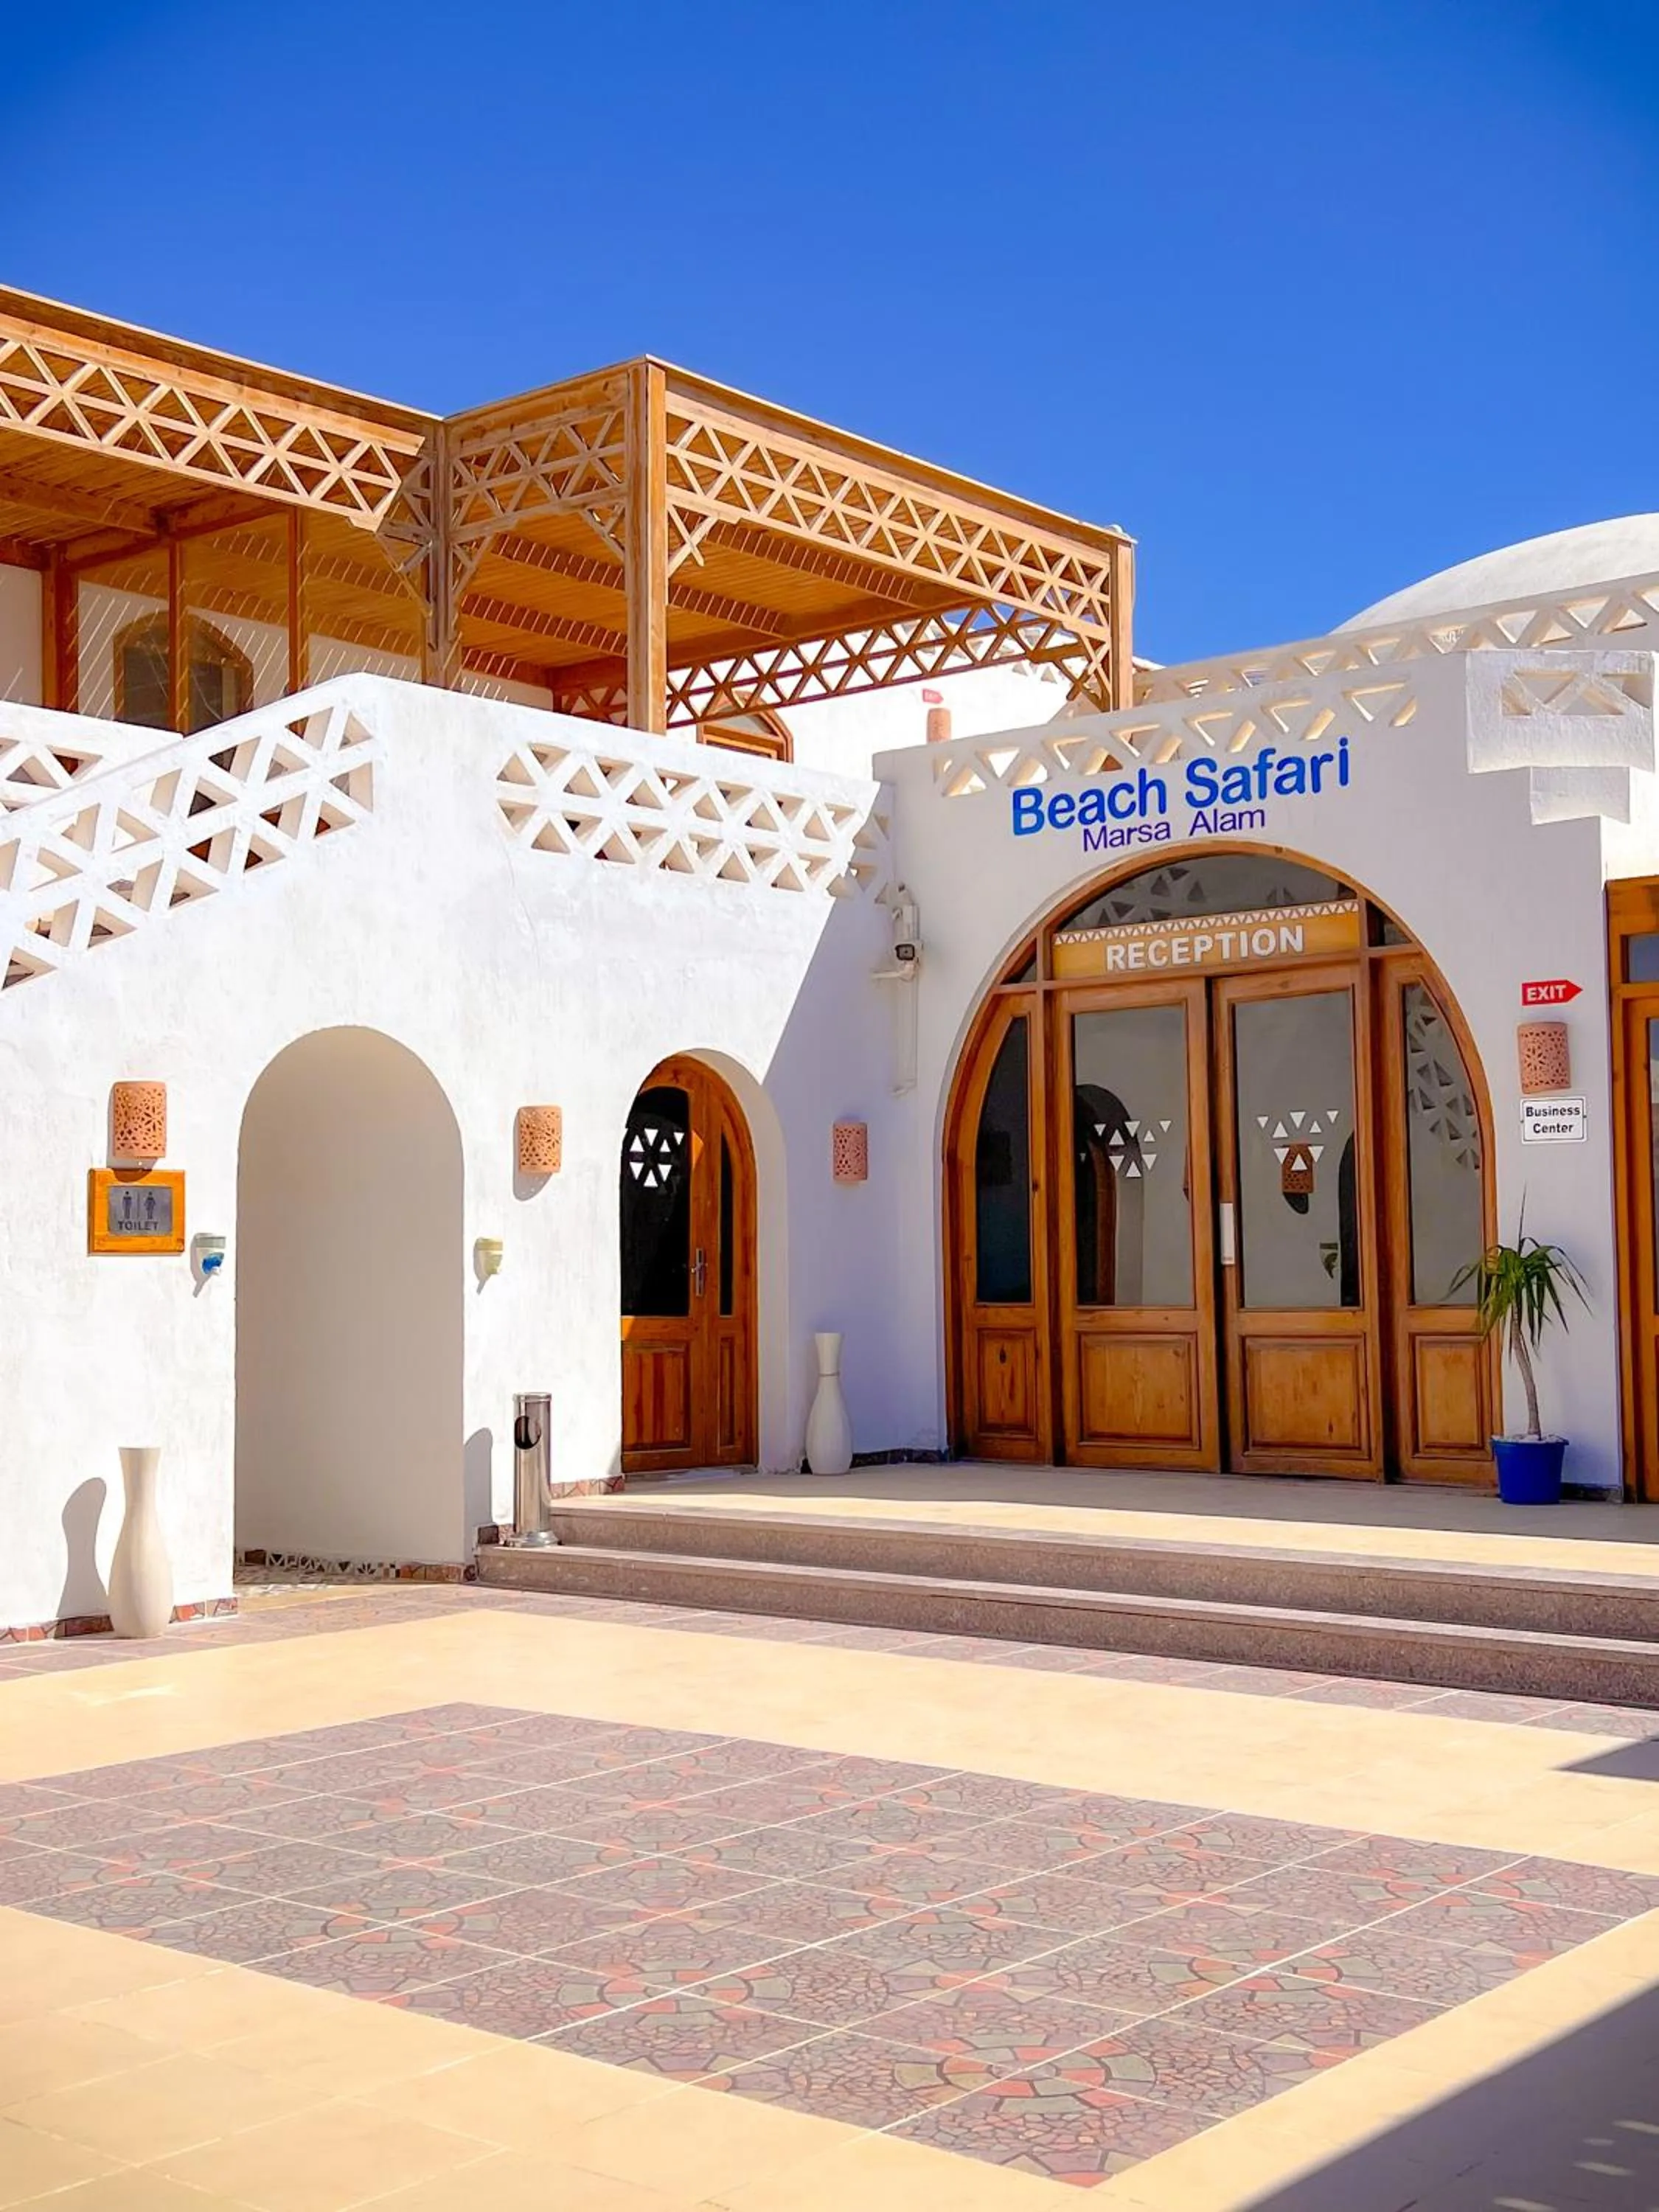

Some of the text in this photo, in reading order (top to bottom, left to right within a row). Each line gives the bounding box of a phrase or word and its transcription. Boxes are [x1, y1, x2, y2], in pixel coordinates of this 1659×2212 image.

[1012, 736, 1350, 836] Beach Safari
[1082, 808, 1265, 852] Marsa Alam
[1106, 925, 1304, 972] RECEPTION
[1527, 984, 1567, 1001] EXIT
[1526, 1107, 1580, 1118] Business
[1533, 1123, 1573, 1134] Center
[117, 1220, 159, 1231] TOILET
